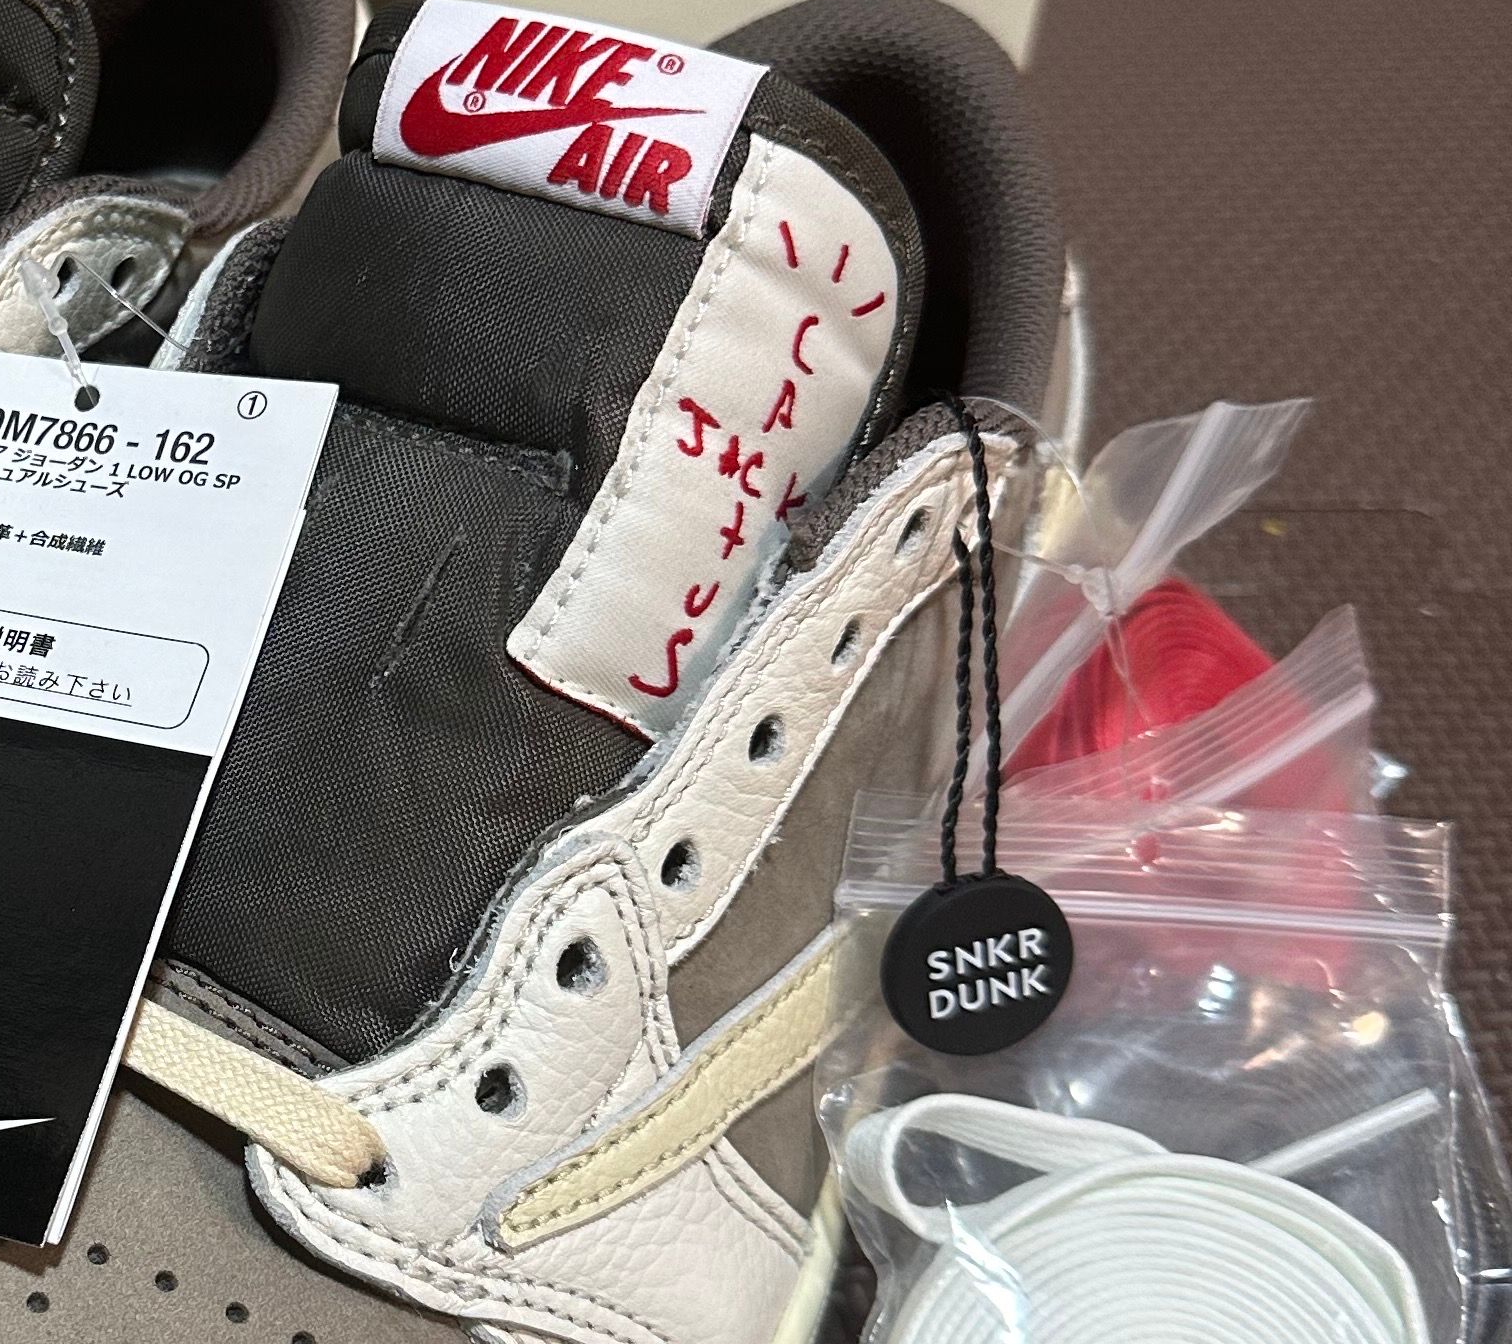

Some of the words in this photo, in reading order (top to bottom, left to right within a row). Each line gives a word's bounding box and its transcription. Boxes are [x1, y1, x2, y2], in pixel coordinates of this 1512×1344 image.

[446, 17, 656, 108] NIKE
[546, 121, 692, 216] AIR
[154, 429, 215, 465] 162
[109, 462, 120, 477] 1
[127, 464, 174, 483] LOW
[178, 470, 209, 487] OG
[213, 473, 241, 490] SP
[926, 927, 1048, 980] SNKR
[929, 964, 1051, 1019] DUNK
